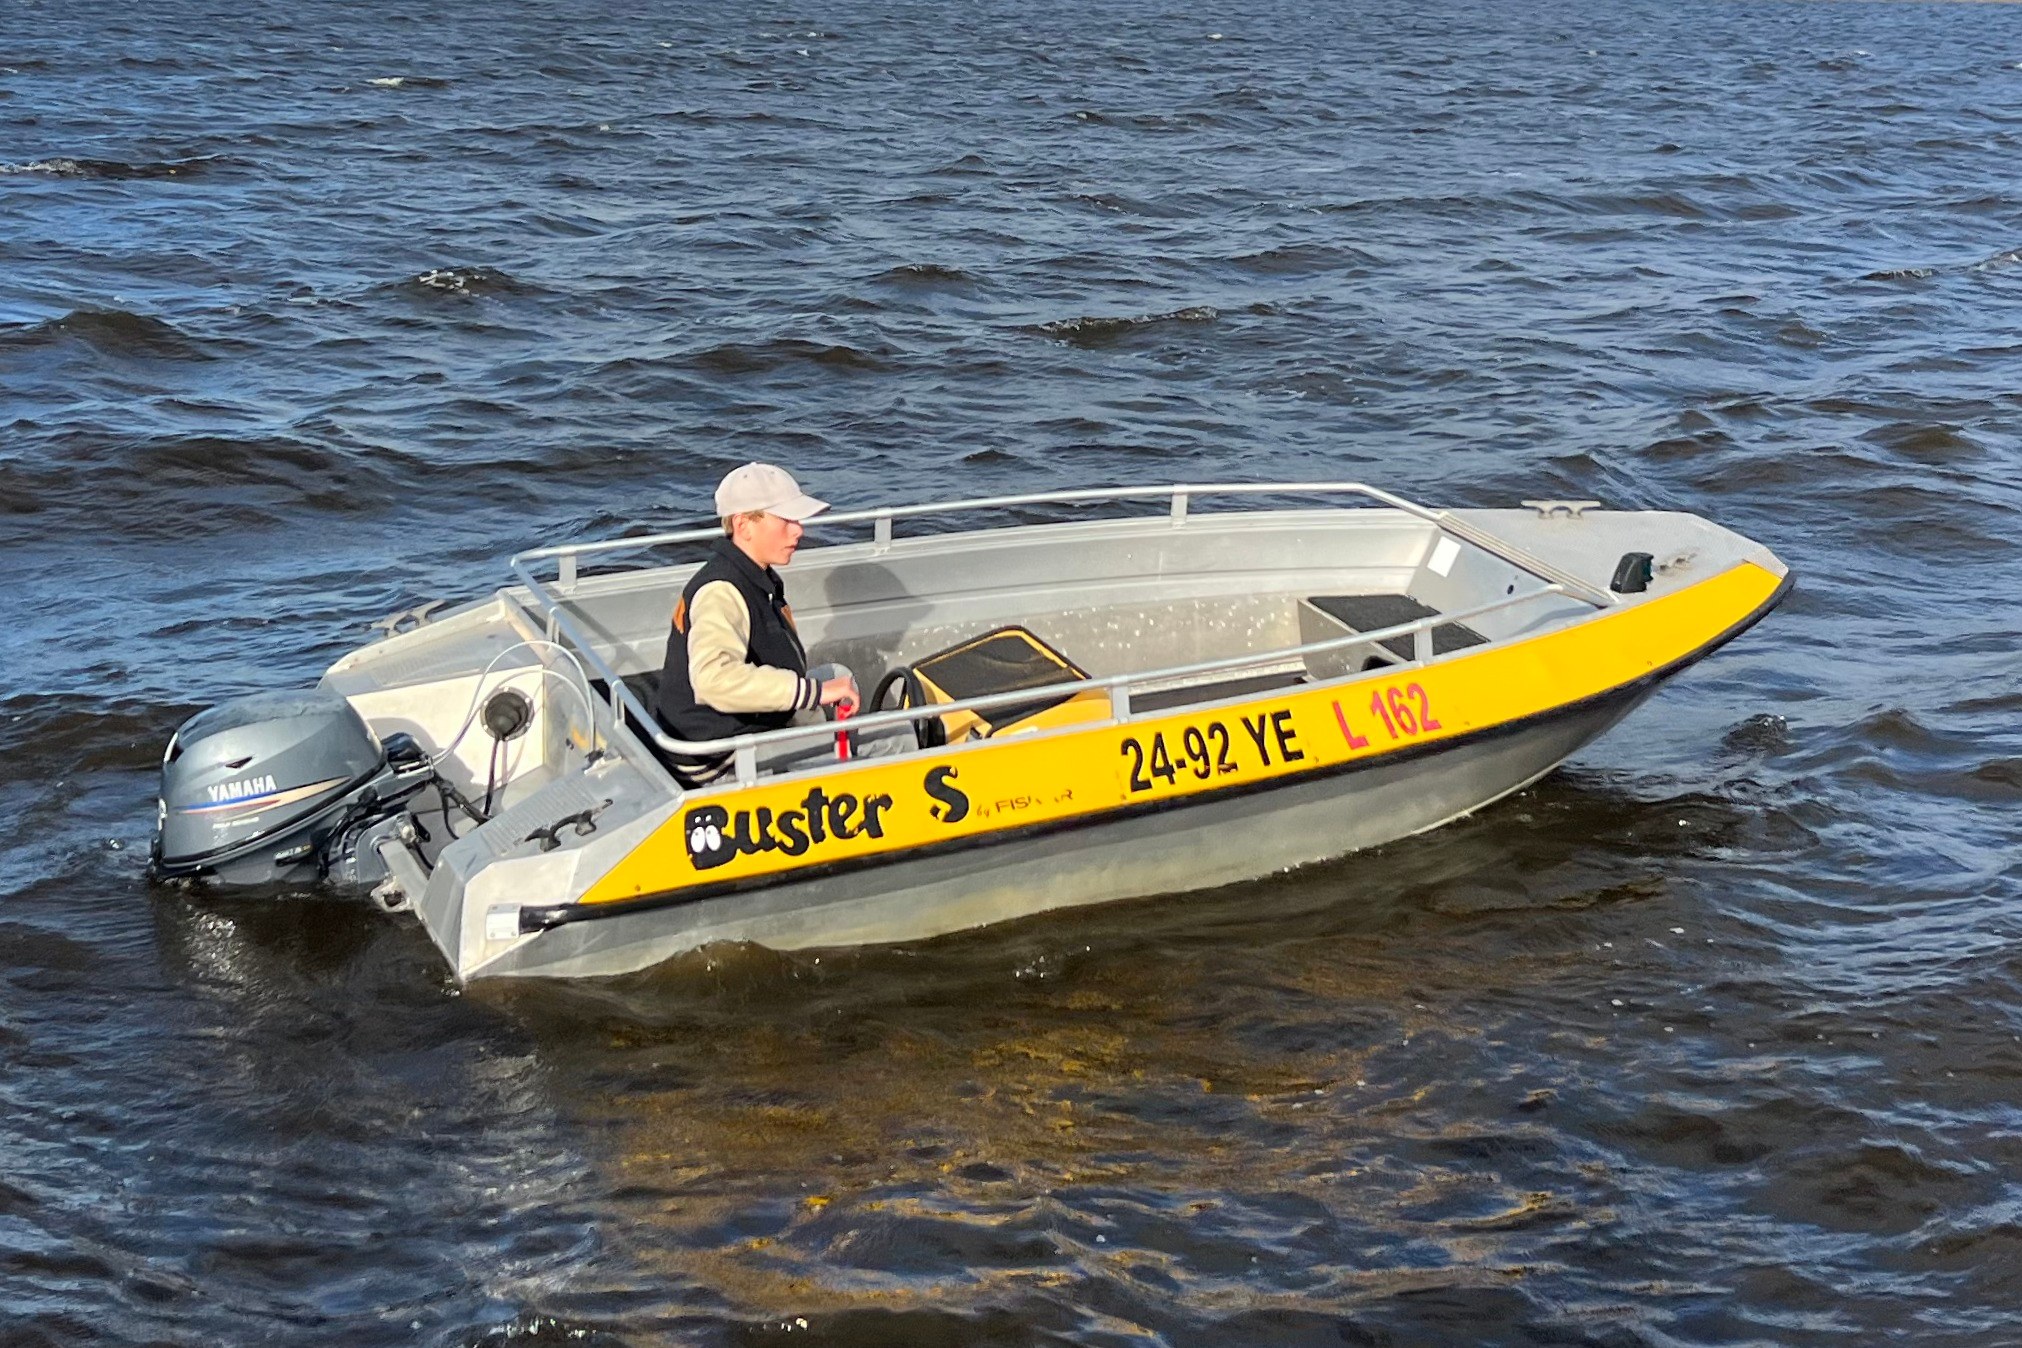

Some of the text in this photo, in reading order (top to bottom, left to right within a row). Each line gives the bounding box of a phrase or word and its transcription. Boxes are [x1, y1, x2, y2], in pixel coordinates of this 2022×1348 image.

[1121, 709, 1304, 792] 24-92 YE
[1332, 682, 1442, 750] L 162
[208, 775, 277, 802] YAMAHA
[684, 765, 969, 871] Buster S
